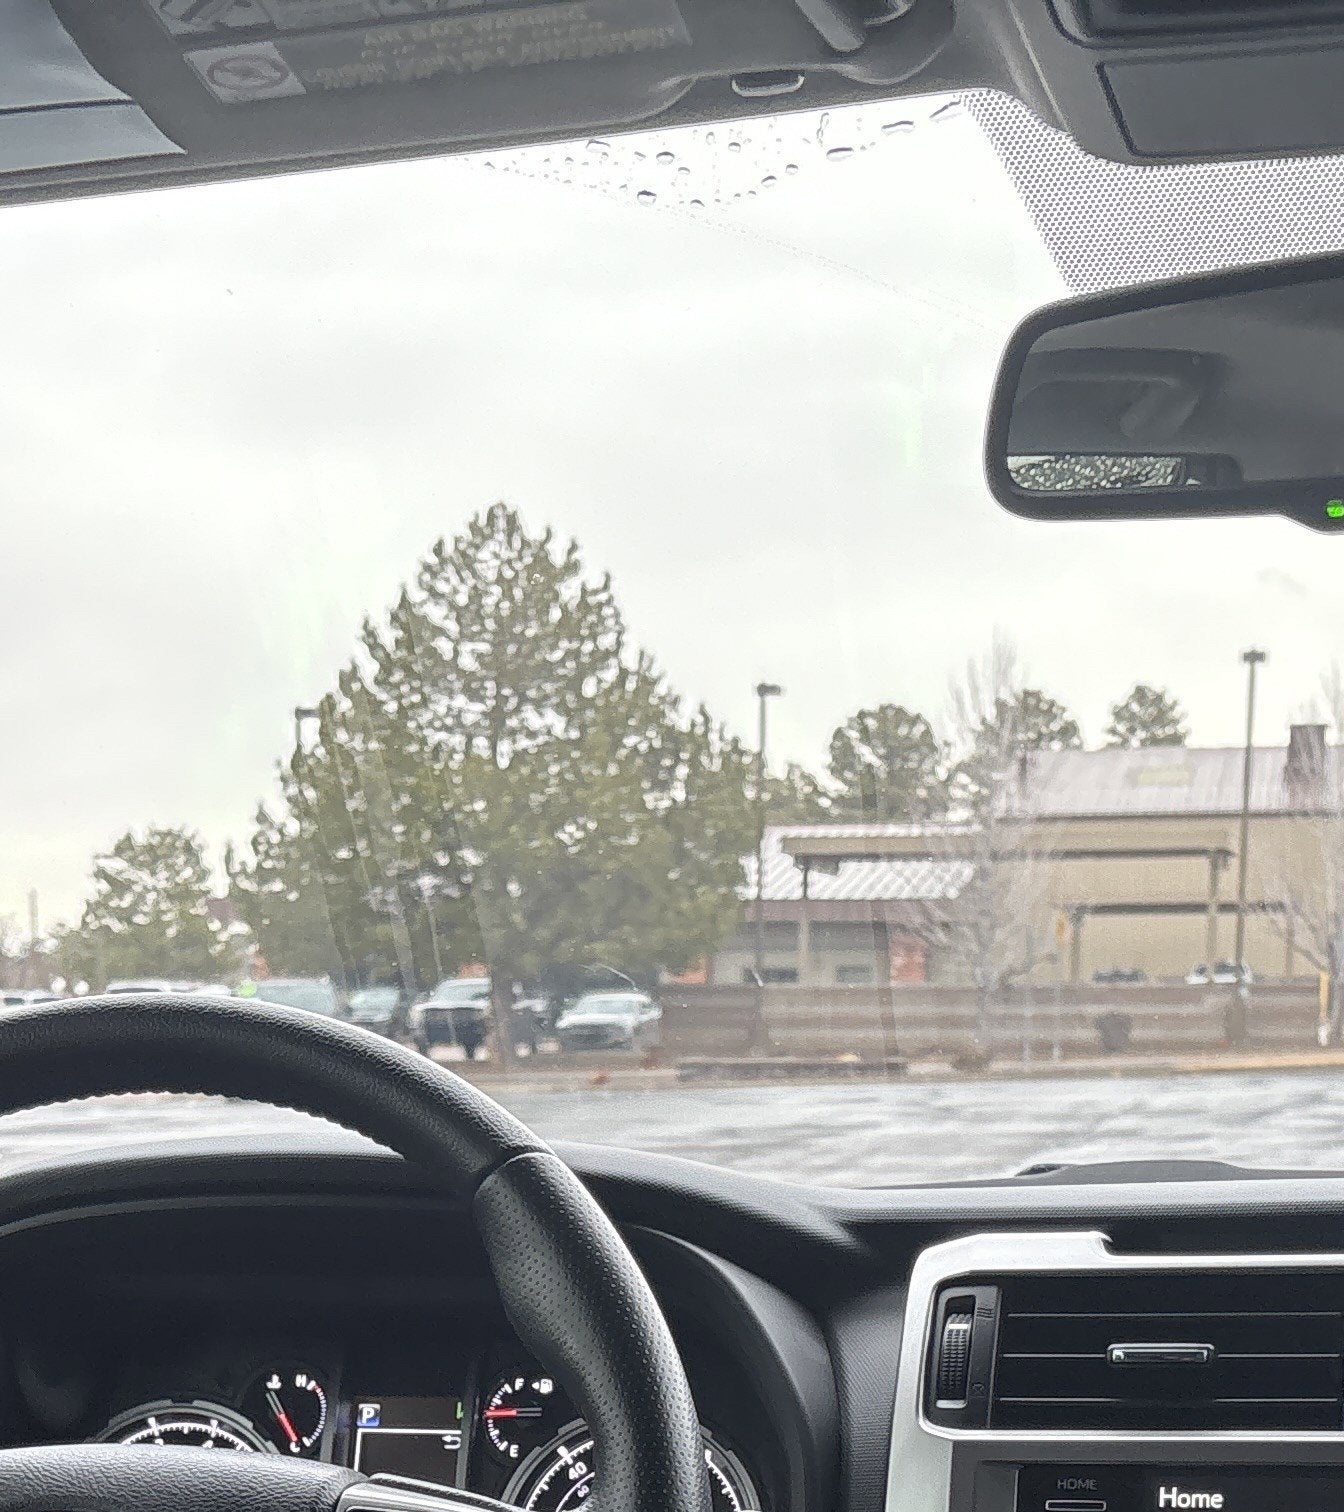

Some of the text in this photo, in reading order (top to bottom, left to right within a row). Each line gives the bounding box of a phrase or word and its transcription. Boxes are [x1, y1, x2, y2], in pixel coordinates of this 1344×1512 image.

[296, 1374, 307, 1387] H
[515, 1378, 524, 1390] F
[361, 1407, 375, 1424] P
[509, 1444, 519, 1458] E
[568, 1461, 588, 1480] 40
[1057, 1478, 1097, 1490] HOME
[1158, 1486, 1224, 1508] Home
